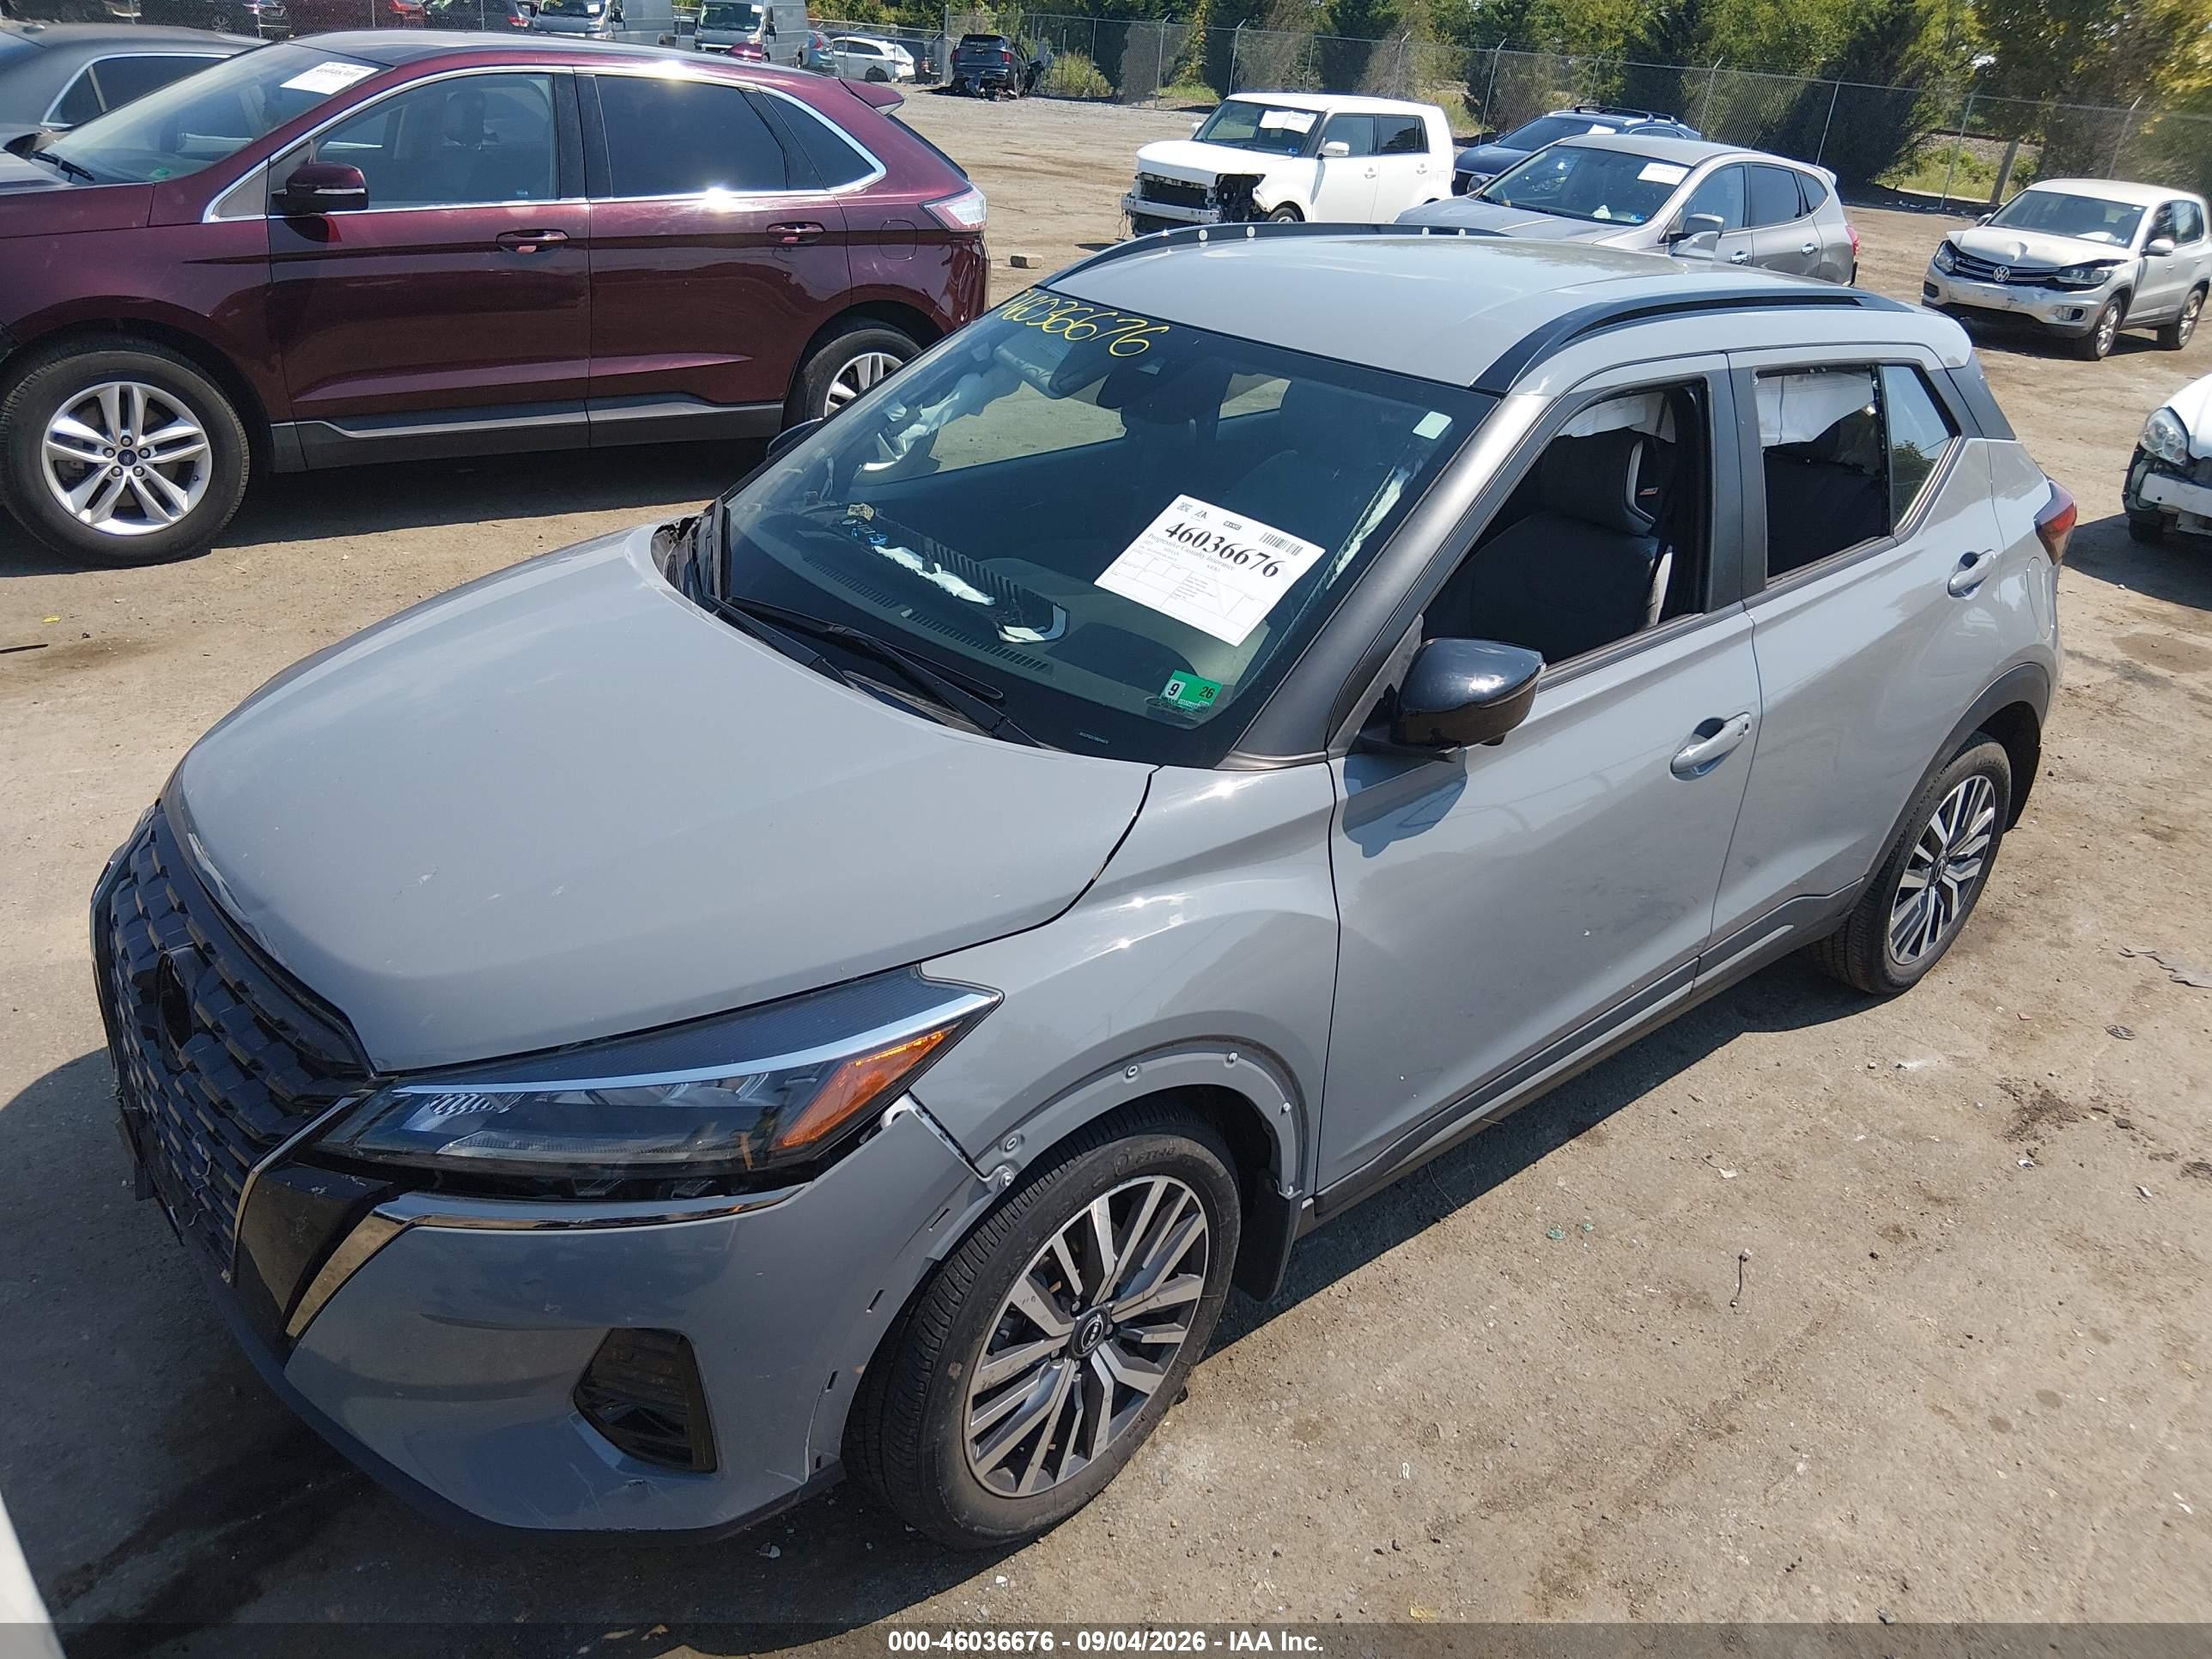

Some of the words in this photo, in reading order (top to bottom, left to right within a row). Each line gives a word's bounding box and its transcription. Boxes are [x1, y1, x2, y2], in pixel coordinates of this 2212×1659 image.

[997, 291, 1170, 357] 46036676
[1165, 522, 1285, 577] 46036676
[1168, 683, 1180, 696] 9
[1199, 686, 1216, 699] 26
